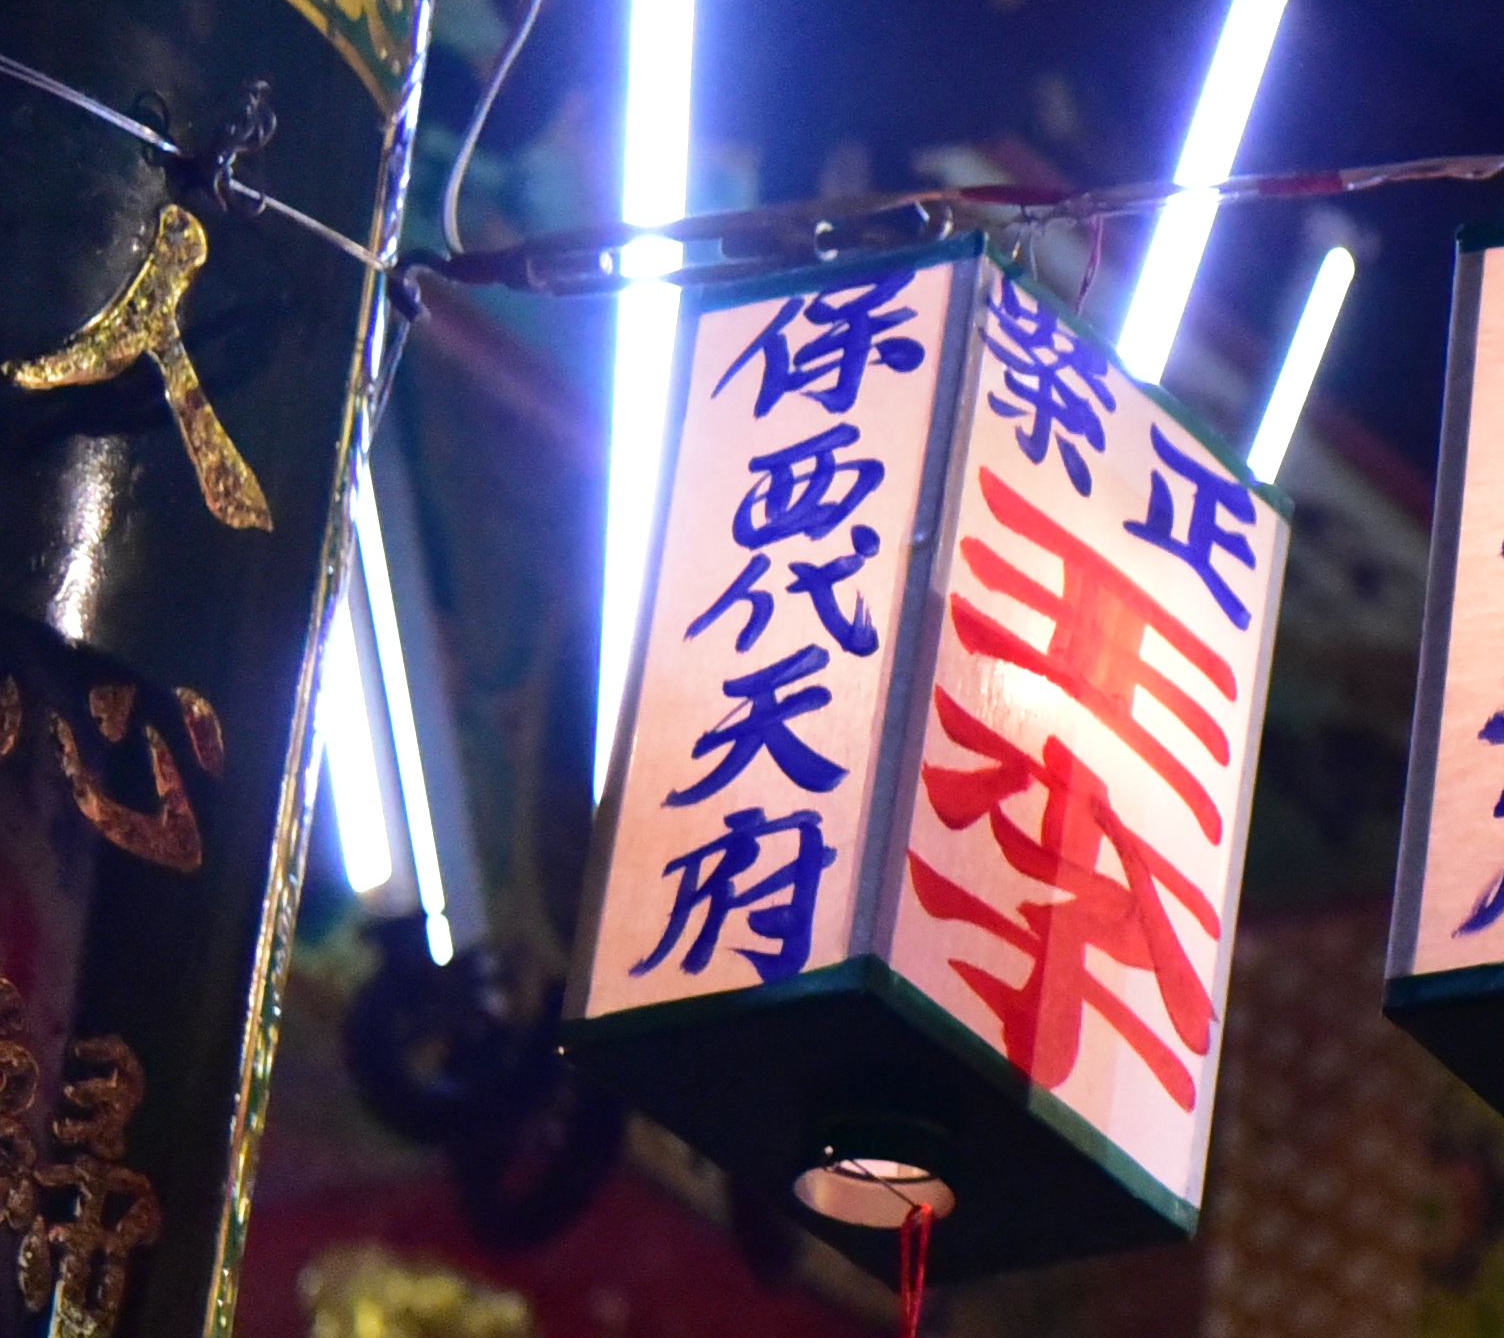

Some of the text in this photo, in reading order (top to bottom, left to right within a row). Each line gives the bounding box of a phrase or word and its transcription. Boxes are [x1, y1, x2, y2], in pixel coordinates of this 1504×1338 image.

[630, 271, 928, 979] 保西代天府
